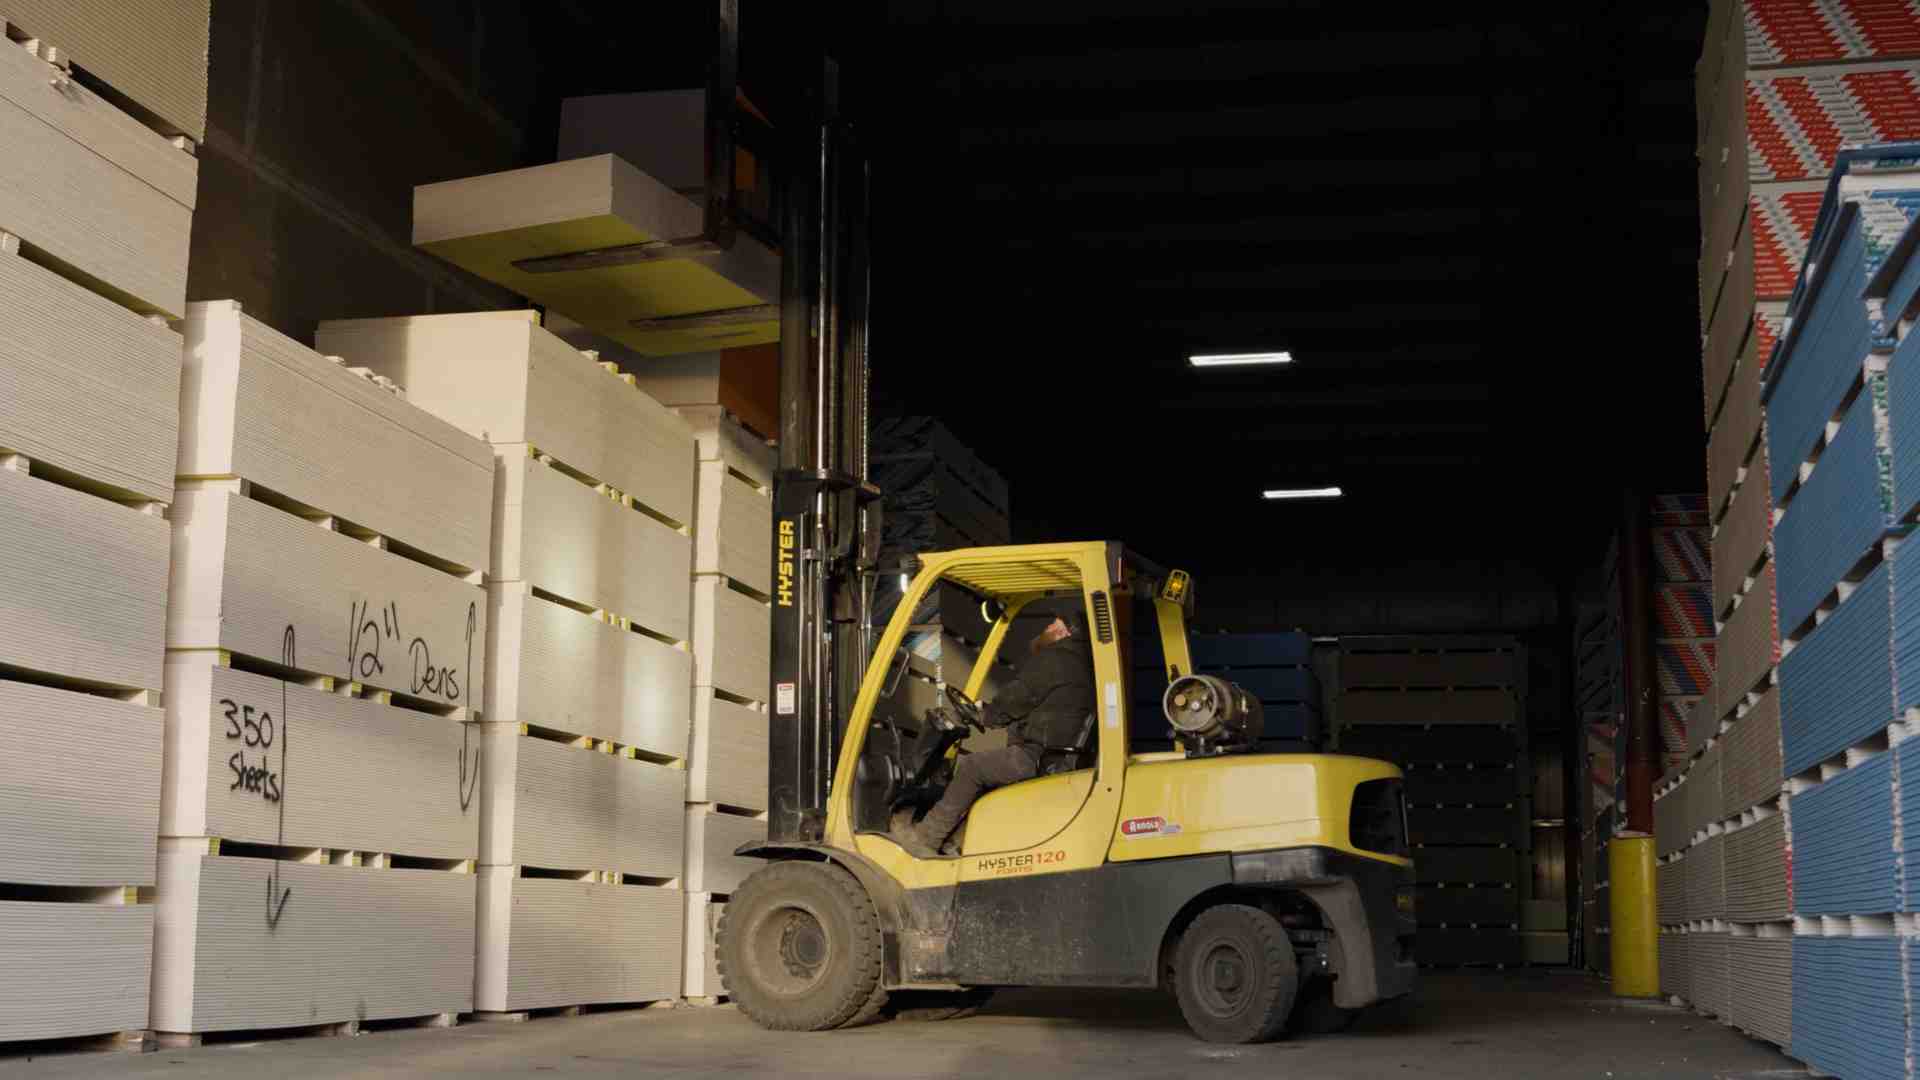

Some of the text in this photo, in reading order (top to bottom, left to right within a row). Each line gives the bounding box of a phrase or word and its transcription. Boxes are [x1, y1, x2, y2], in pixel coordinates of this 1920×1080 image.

[778, 520, 794, 607] HYSTER
[408, 637, 460, 700] Dens
[219, 698, 274, 748] 350
[228, 751, 281, 803] Sheets
[978, 850, 1066, 872] HYSTER 120
